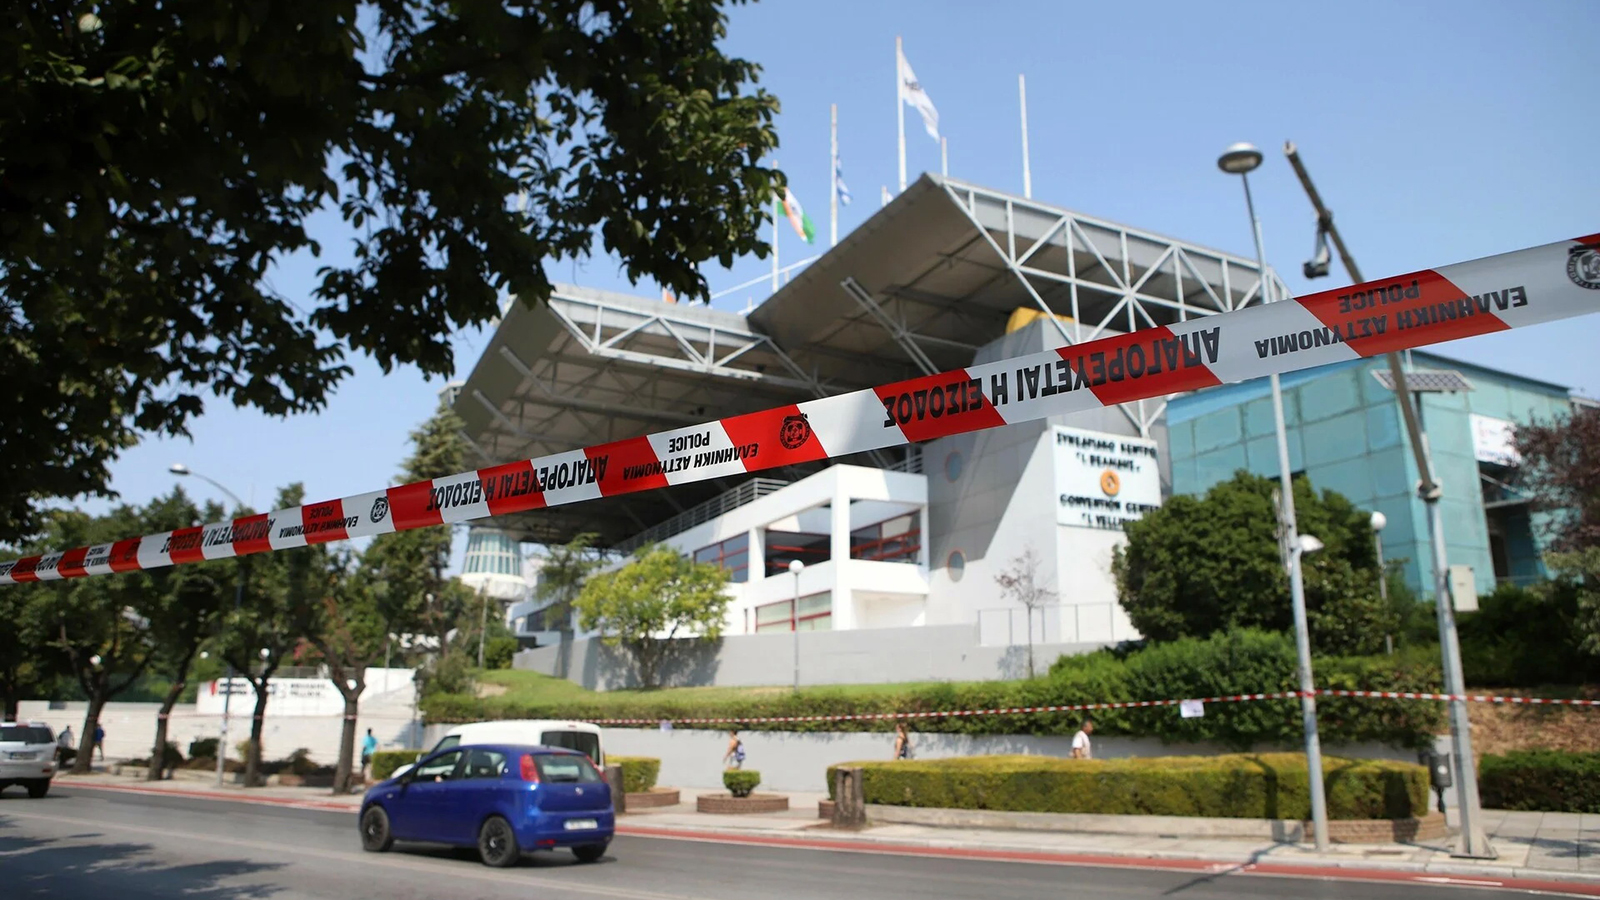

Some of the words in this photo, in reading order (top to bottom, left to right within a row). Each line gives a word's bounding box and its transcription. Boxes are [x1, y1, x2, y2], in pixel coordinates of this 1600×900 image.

[1337, 279, 1420, 314] POLICE
[1397, 286, 1528, 331] ΕΛΛΗΝΙΚΗ
[1255, 314, 1387, 359] ΑΣΤΥΝΟΜΙΑ
[1016, 326, 1221, 402] ΑΠΑΓΟΡΕΥΕΤΑΙ
[883, 378, 983, 428] ΕΙΣΟΔΟΣ
[991, 373, 1008, 406] Η
[668, 431, 711, 453] POLICE
[693, 443, 759, 468] ΕΛΛΗΝΙΚΗ
[498, 454, 608, 499] ΑΠΑΓΟΡΕΥΕΤΑΙ
[622, 454, 692, 480] ΑΣΤΥΝΟΜΙΑ
[426, 480, 483, 511] ΕΙΣΟΔΟΣ
[484, 476, 497, 501] Η
[1060, 493, 1120, 511] CONVENTION
[309, 505, 334, 519] POLICE
[319, 515, 359, 532] ΕΛΛΗΝΙΚΗ
